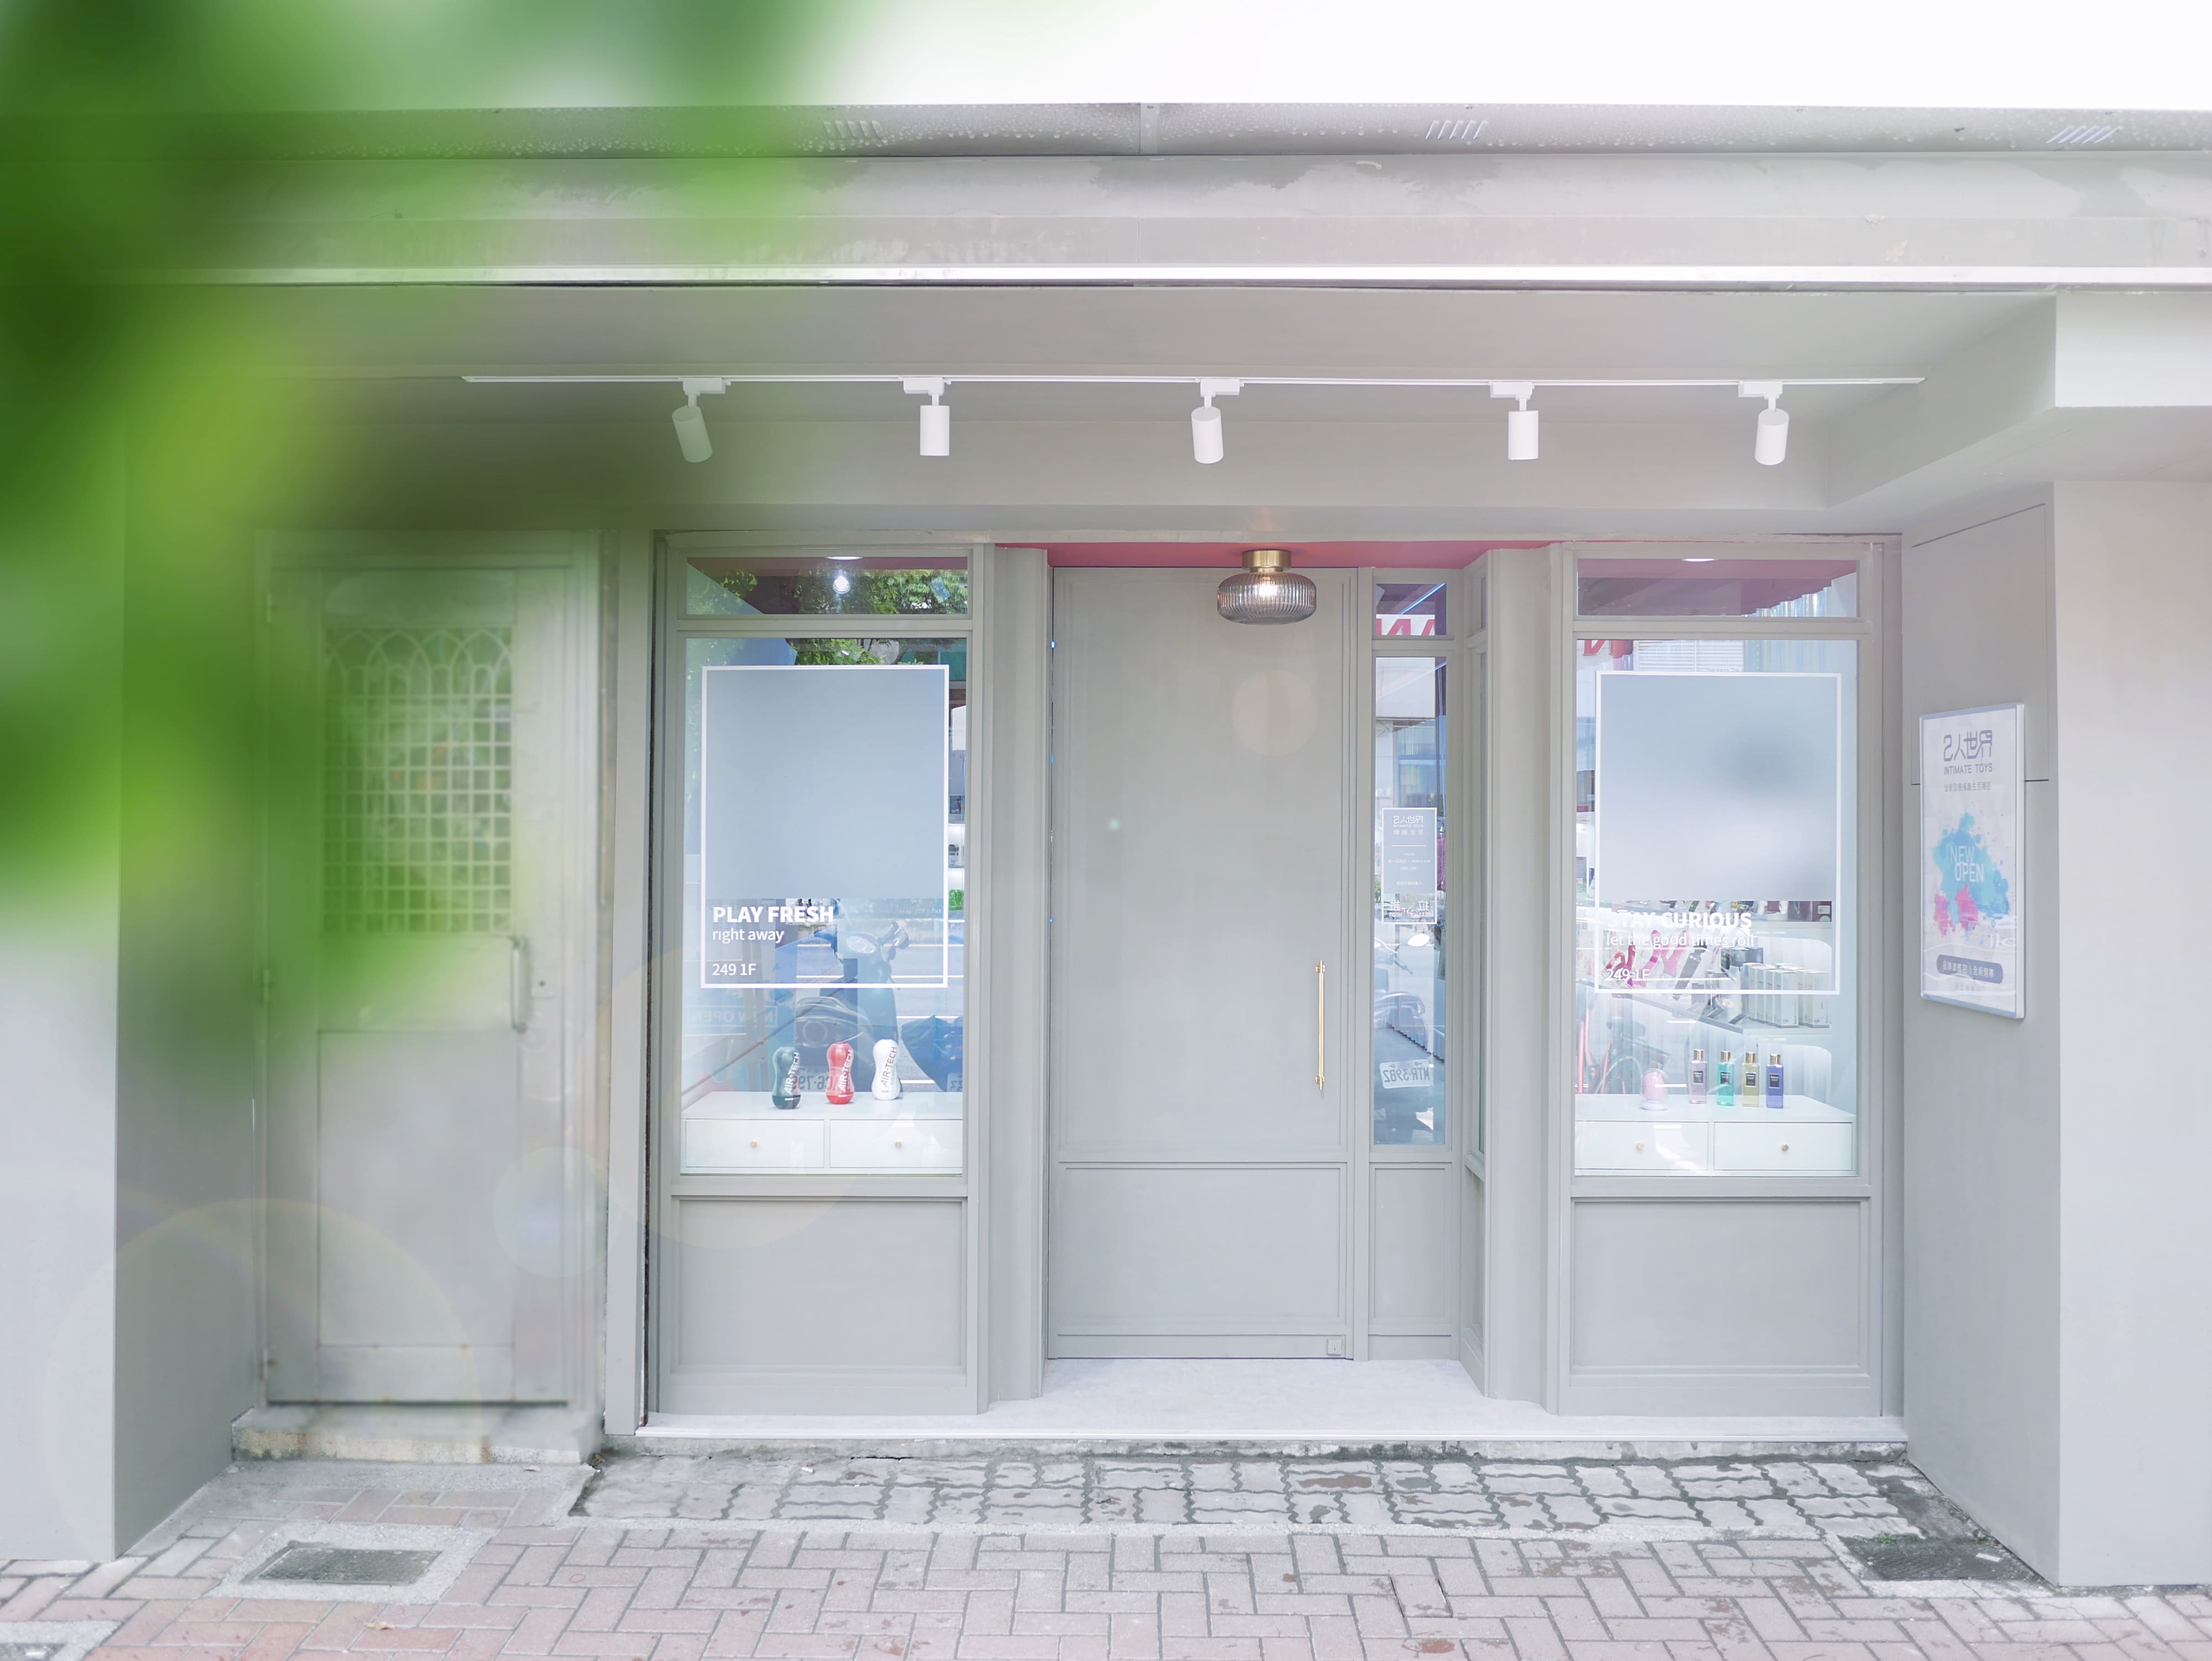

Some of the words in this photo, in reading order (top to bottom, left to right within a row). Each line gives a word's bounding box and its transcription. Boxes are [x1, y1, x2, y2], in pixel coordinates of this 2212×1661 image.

[1943, 764, 1972, 775] INTIMATE
[1975, 763, 1993, 773] TOYS
[1950, 846, 1975, 863] NEW
[1954, 862, 1985, 882] OPEN
[713, 906, 763, 923] PLAY
[768, 906, 834, 923] FRESH
[1607, 912, 1657, 928] STAY
[1661, 912, 1752, 929] CURIOUS
[712, 927, 744, 944] right
[747, 931, 784, 944] away
[1606, 934, 1623, 946] let
[1627, 934, 1651, 946] the
[1653, 934, 1687, 949] good
[1690, 934, 1729, 946] times
[1732, 934, 1755, 946] roll
[712, 962, 737, 976] 249
[740, 963, 756, 976] 1F
[1606, 969, 1630, 981] 249
[1634, 969, 1650, 980] 1F
[784, 1052, 800, 1094] AIR-TECH
[837, 1049, 854, 1094] AIR-TECH
[881, 1046, 897, 1087] AIR-TECH
